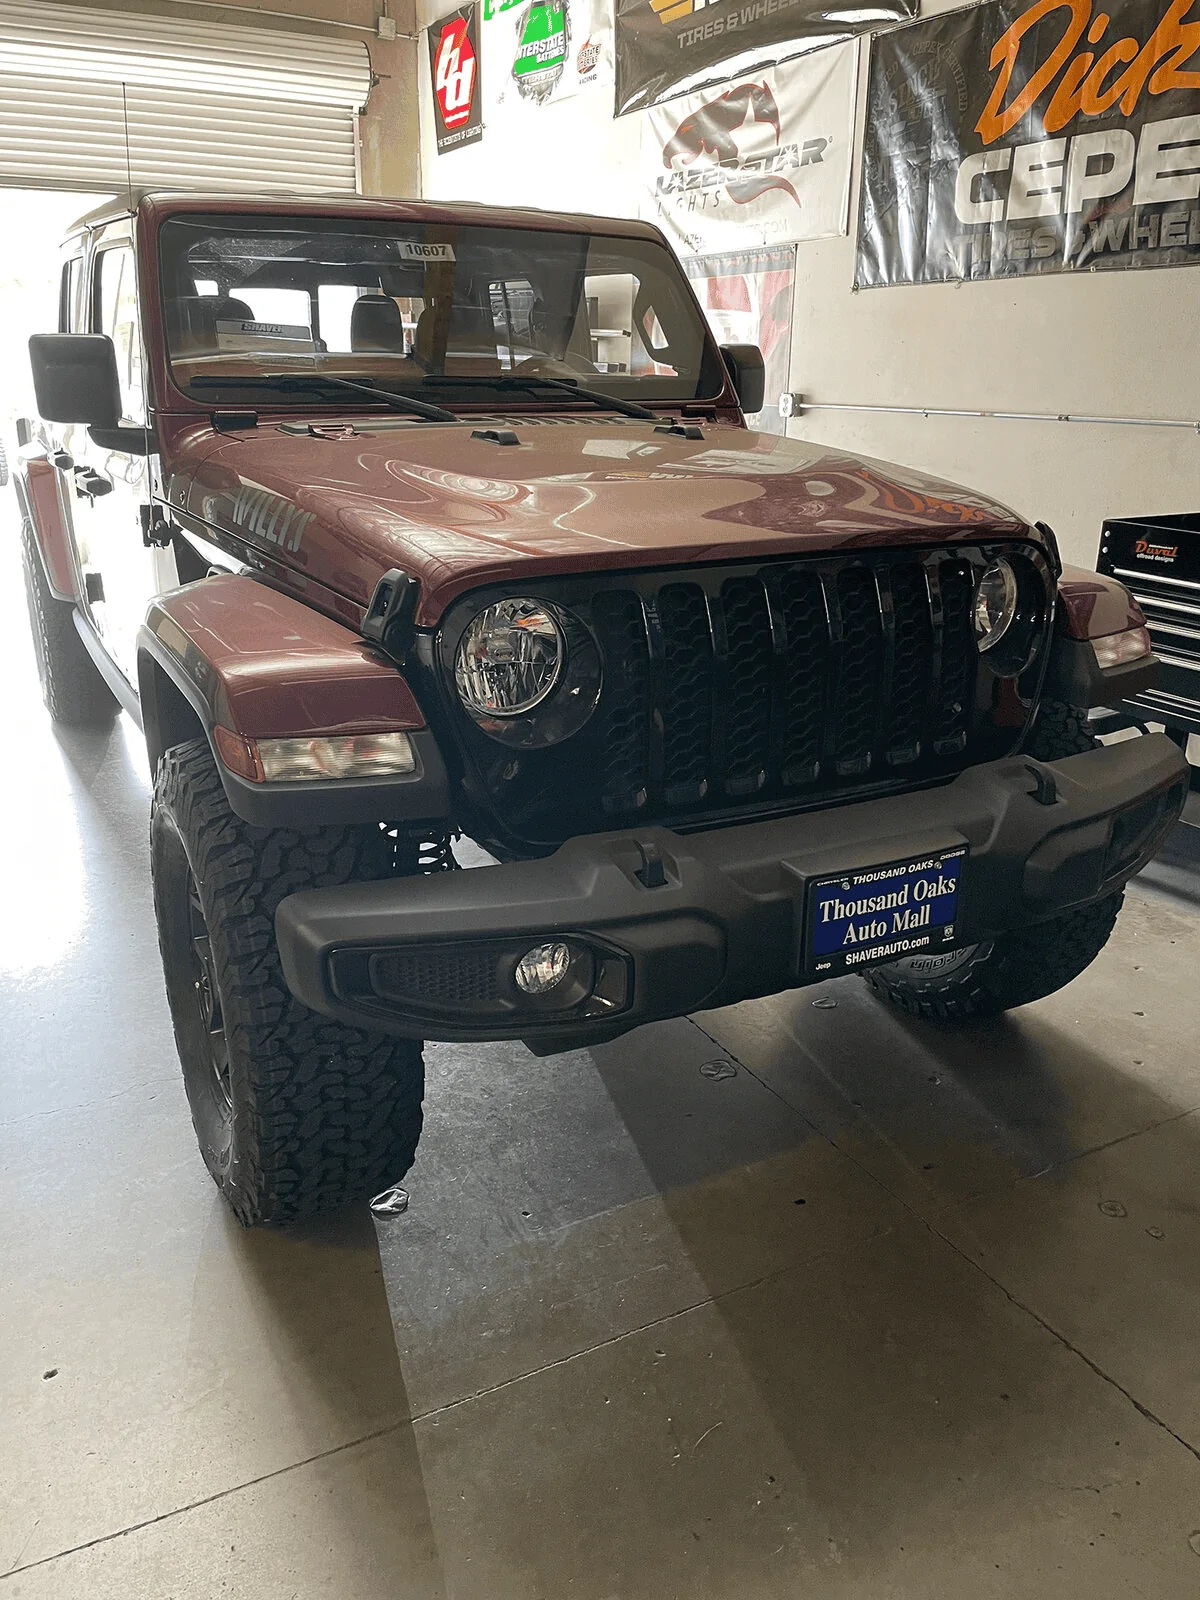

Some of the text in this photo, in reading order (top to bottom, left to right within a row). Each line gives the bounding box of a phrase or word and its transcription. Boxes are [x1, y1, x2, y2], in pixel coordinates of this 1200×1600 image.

[677, 17, 724, 48] TIRES
[726, 12, 738, 30] &
[406, 243, 446, 257] 10607
[1135, 540, 1178, 557] Duval
[939, 849, 966, 860] DODGE
[853, 859, 934, 886] THOUSAND OAKS
[819, 875, 956, 923] Thousand Oaks
[842, 904, 931, 946] Auto Mall
[845, 935, 930, 965] SHAVERAUTO.com
[815, 961, 831, 971] Jeep
